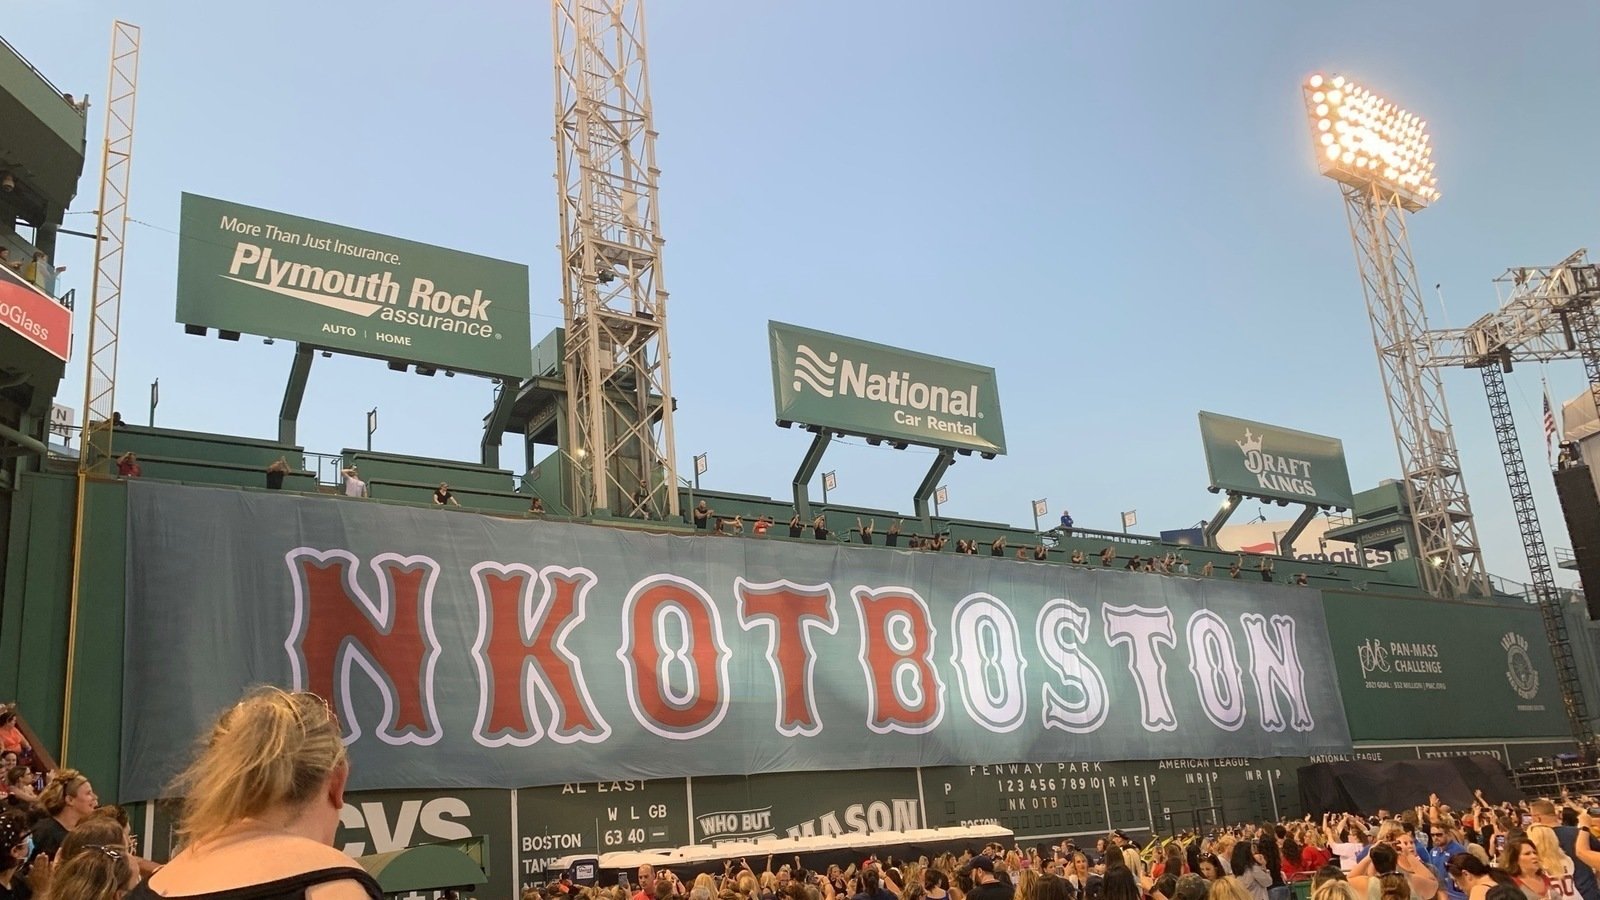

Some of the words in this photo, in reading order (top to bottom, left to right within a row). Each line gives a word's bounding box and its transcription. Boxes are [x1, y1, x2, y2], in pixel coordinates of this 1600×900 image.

[220, 215, 261, 237] More
[265, 224, 300, 245] Than
[302, 233, 332, 252] Just
[333, 239, 401, 266] Insurance.
[229, 242, 400, 304] Plymouth
[408, 277, 492, 321] Rock
[380, 307, 493, 338] assurance
[322, 323, 357, 337] AUTO
[376, 332, 412, 346] HOME
[838, 359, 978, 418] National
[894, 410, 921, 426] Car
[927, 417, 977, 437] Rental
[1243, 450, 1312, 478] DRAFT
[1256, 470, 1317, 497] KINGS
[1390, 642, 1439, 658] PAN-MASS
[1394, 660, 1443, 674] CHALLENGE
[970, 763, 1044, 776] FENWAY
[1058, 761, 1102, 773] PARK
[1158, 758, 1210, 770] AMERICAN
[1214, 757, 1250, 767] LEAGUE
[1310, 754, 1350, 764] NATIONAL
[562, 781, 587, 794] AL
[597, 779, 646, 792] EAST
[944, 783, 951, 795] P
[608, 807, 618, 821] W
[631, 806, 640, 820] L
[648, 804, 667, 818] GB
[700, 813, 738, 836] WHO
[741, 810, 772, 832] BUT
[522, 833, 582, 852] BOSTON
[604, 830, 623, 845] 63
[628, 828, 645, 843] 40
